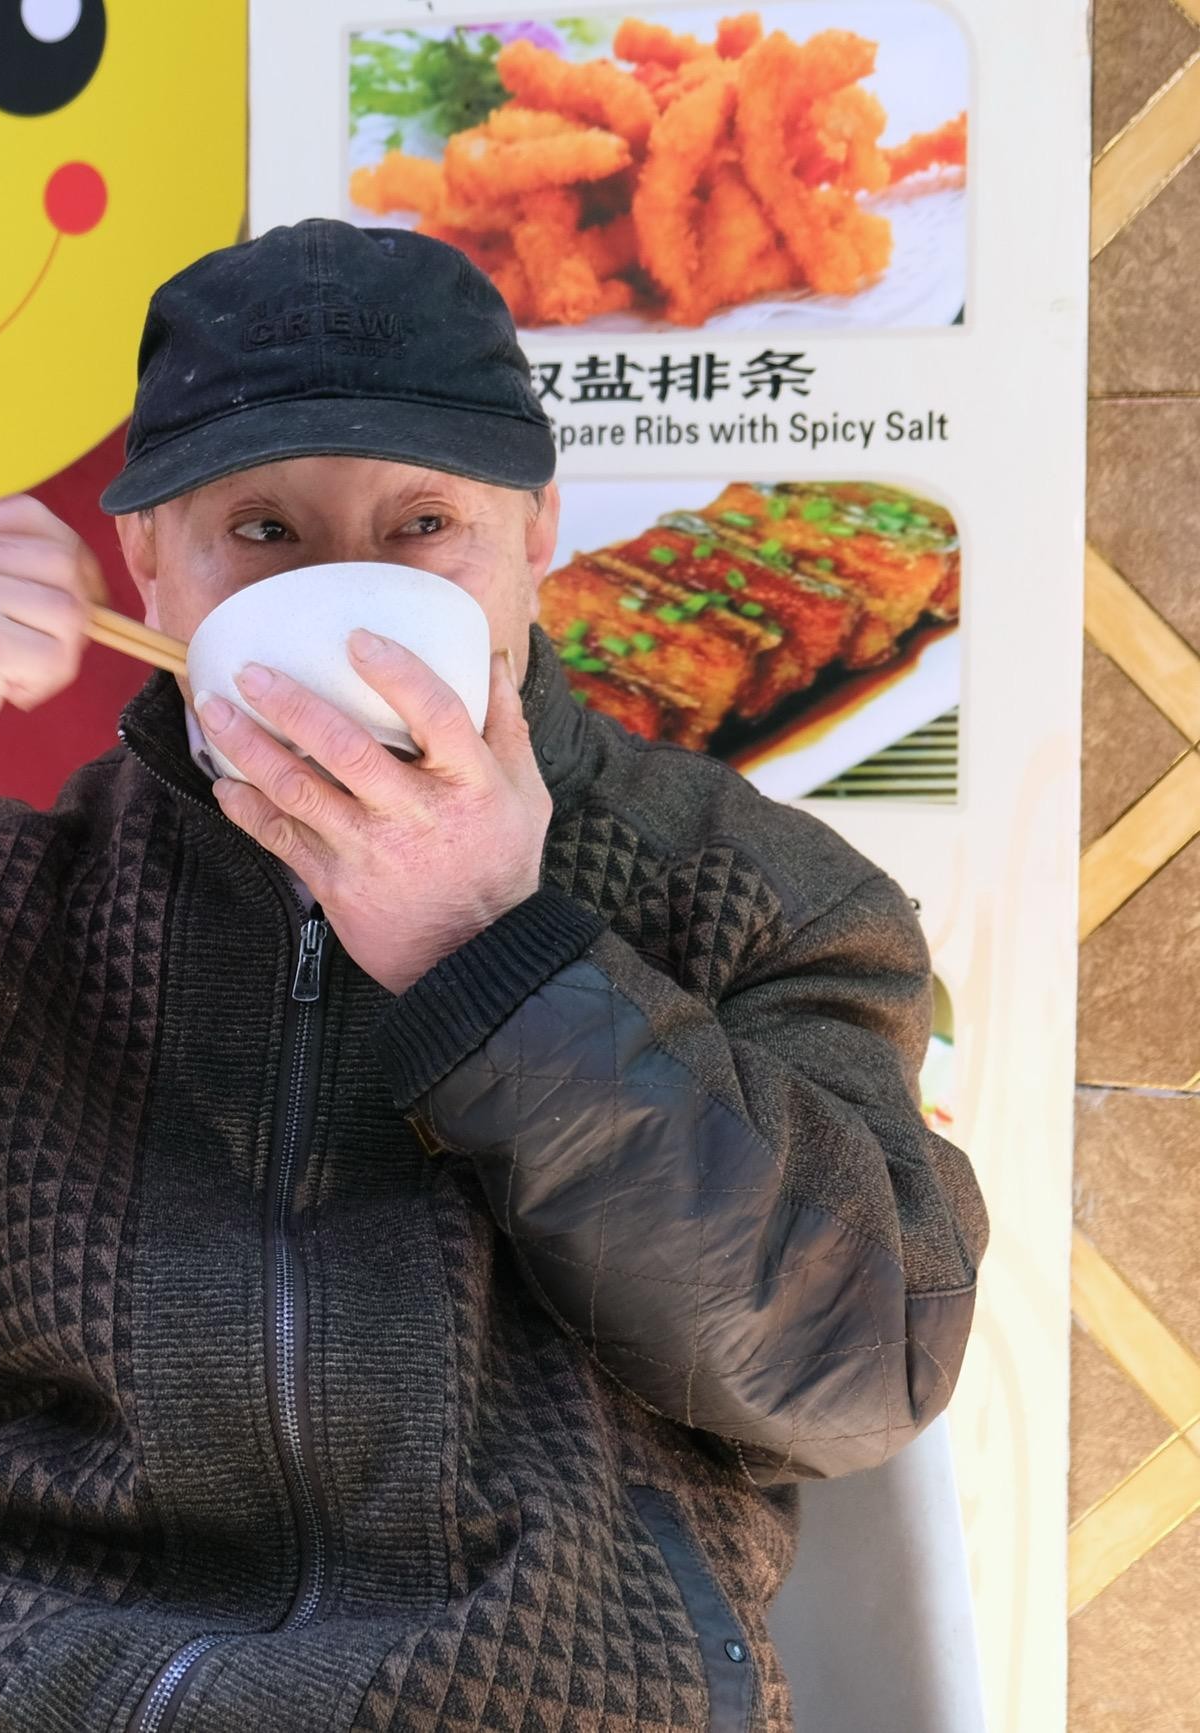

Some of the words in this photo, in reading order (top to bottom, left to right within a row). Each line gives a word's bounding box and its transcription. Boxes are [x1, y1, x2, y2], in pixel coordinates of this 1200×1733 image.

[249, 309, 402, 346] CREW
[636, 414, 700, 445] Ribs
[709, 413, 778, 444] with
[789, 411, 875, 450] Spicy
[885, 410, 950, 442] Salt
